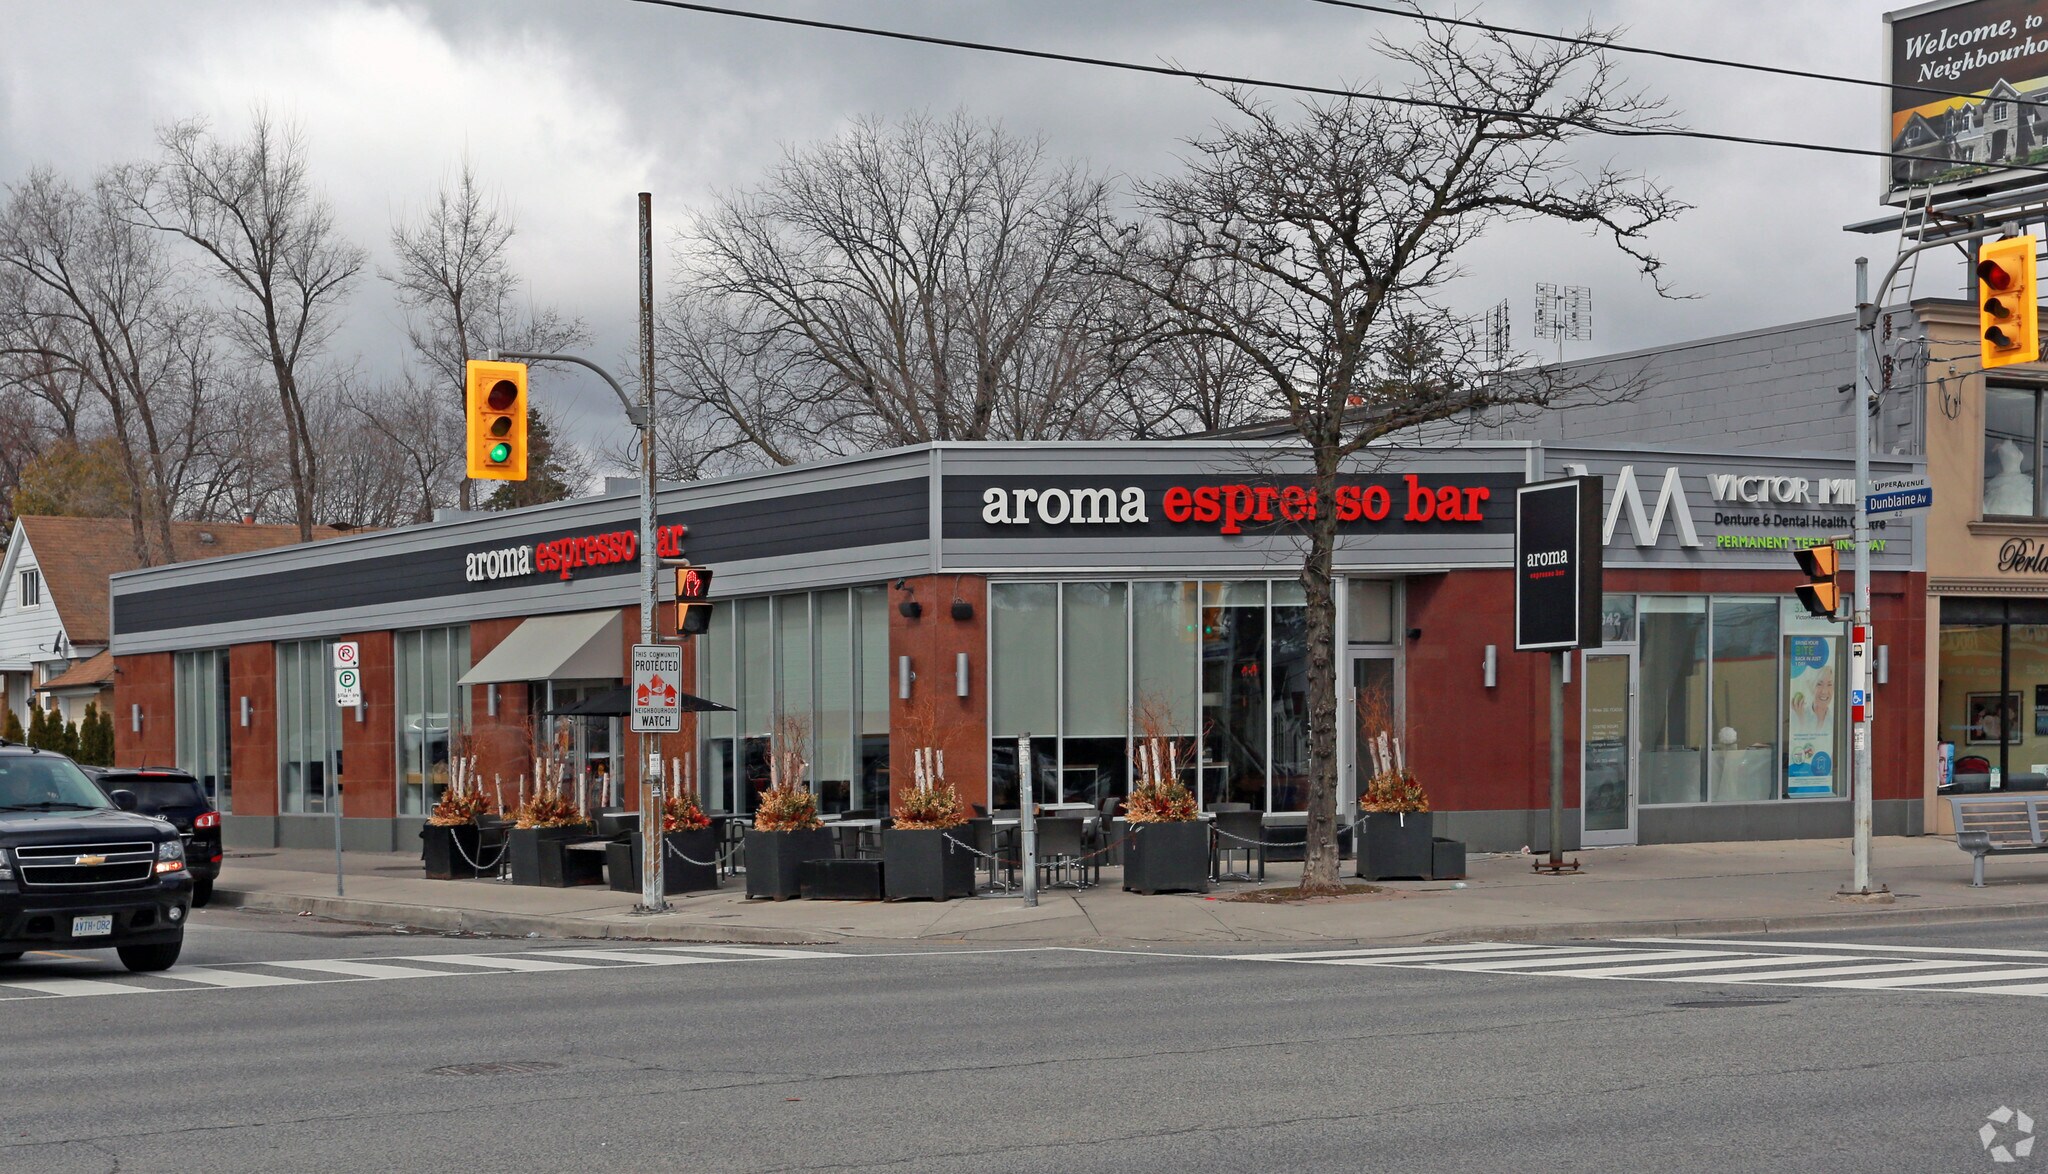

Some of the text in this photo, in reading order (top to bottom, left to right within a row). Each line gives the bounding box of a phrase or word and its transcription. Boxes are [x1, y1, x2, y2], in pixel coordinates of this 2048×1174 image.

[1905, 14, 2043, 61] Welcome, to
[1706, 473, 1811, 504] VICTOR
[982, 486, 1149, 524] aroma
[1404, 474, 1490, 522] bar
[1870, 493, 1927, 511] Dunblaine Av
[1715, 512, 1760, 527] Denture
[1762, 513, 1771, 527] &
[1774, 514, 1809, 528] Dental
[1812, 515, 1848, 529] Health
[1894, 510, 1903, 518] 42
[1717, 535, 1790, 549] PERMANENT
[466, 524, 685, 582] aroma espresso ar
[1527, 550, 1568, 567] aroma
[1795, 645, 1815, 656] BITE
[635, 660, 678, 672] PROTECTED
[344, 674, 352, 684] P
[641, 716, 671, 727] WATCH
